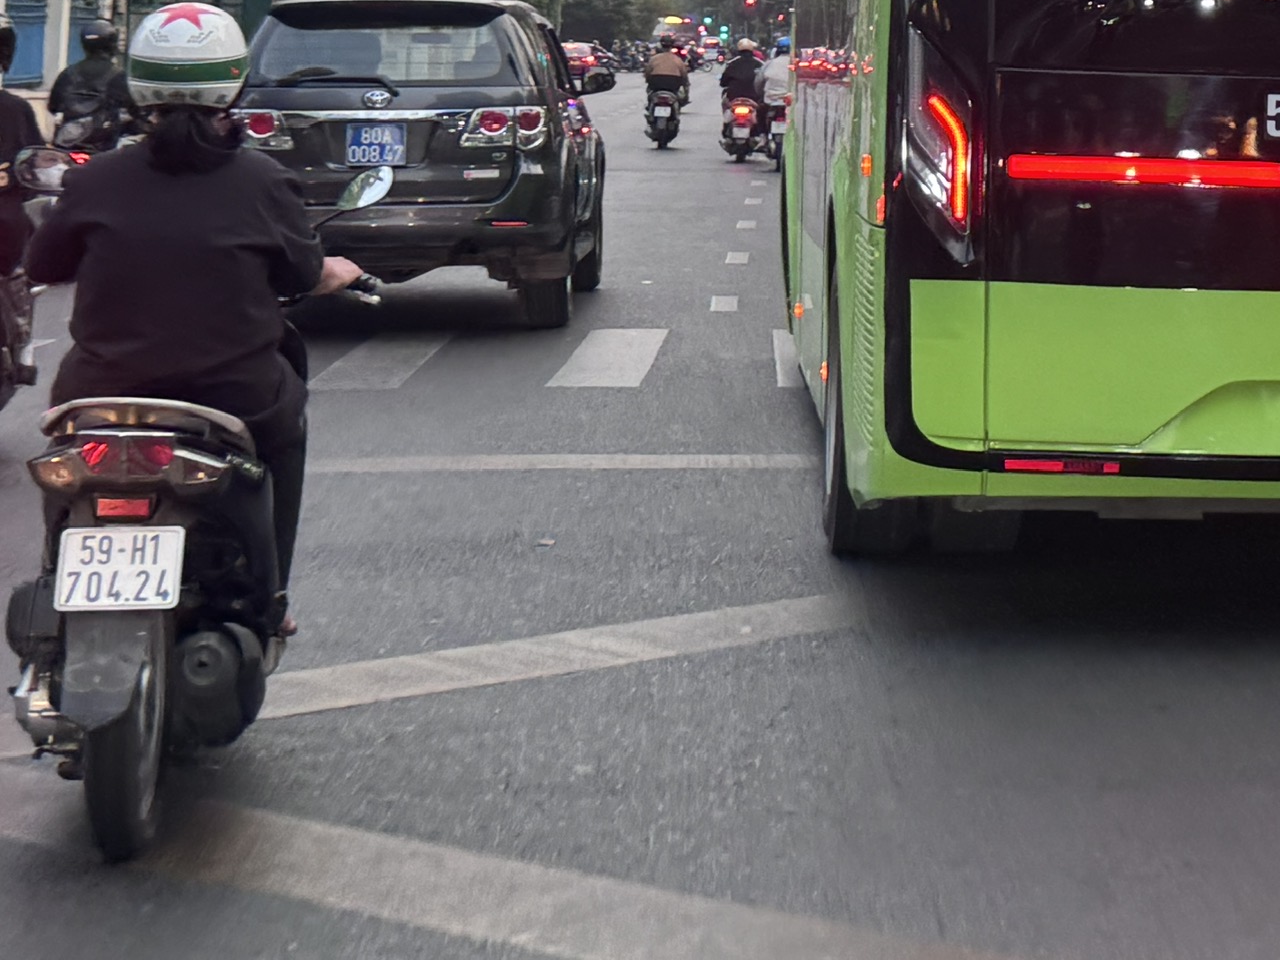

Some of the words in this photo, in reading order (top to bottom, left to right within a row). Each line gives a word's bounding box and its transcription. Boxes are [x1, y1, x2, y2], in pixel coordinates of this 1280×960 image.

[361, 127, 393, 144] 80A
[349, 145, 404, 162] 008.47
[80, 534, 160, 565] 59-H1
[64, 569, 170, 603] 704.24
